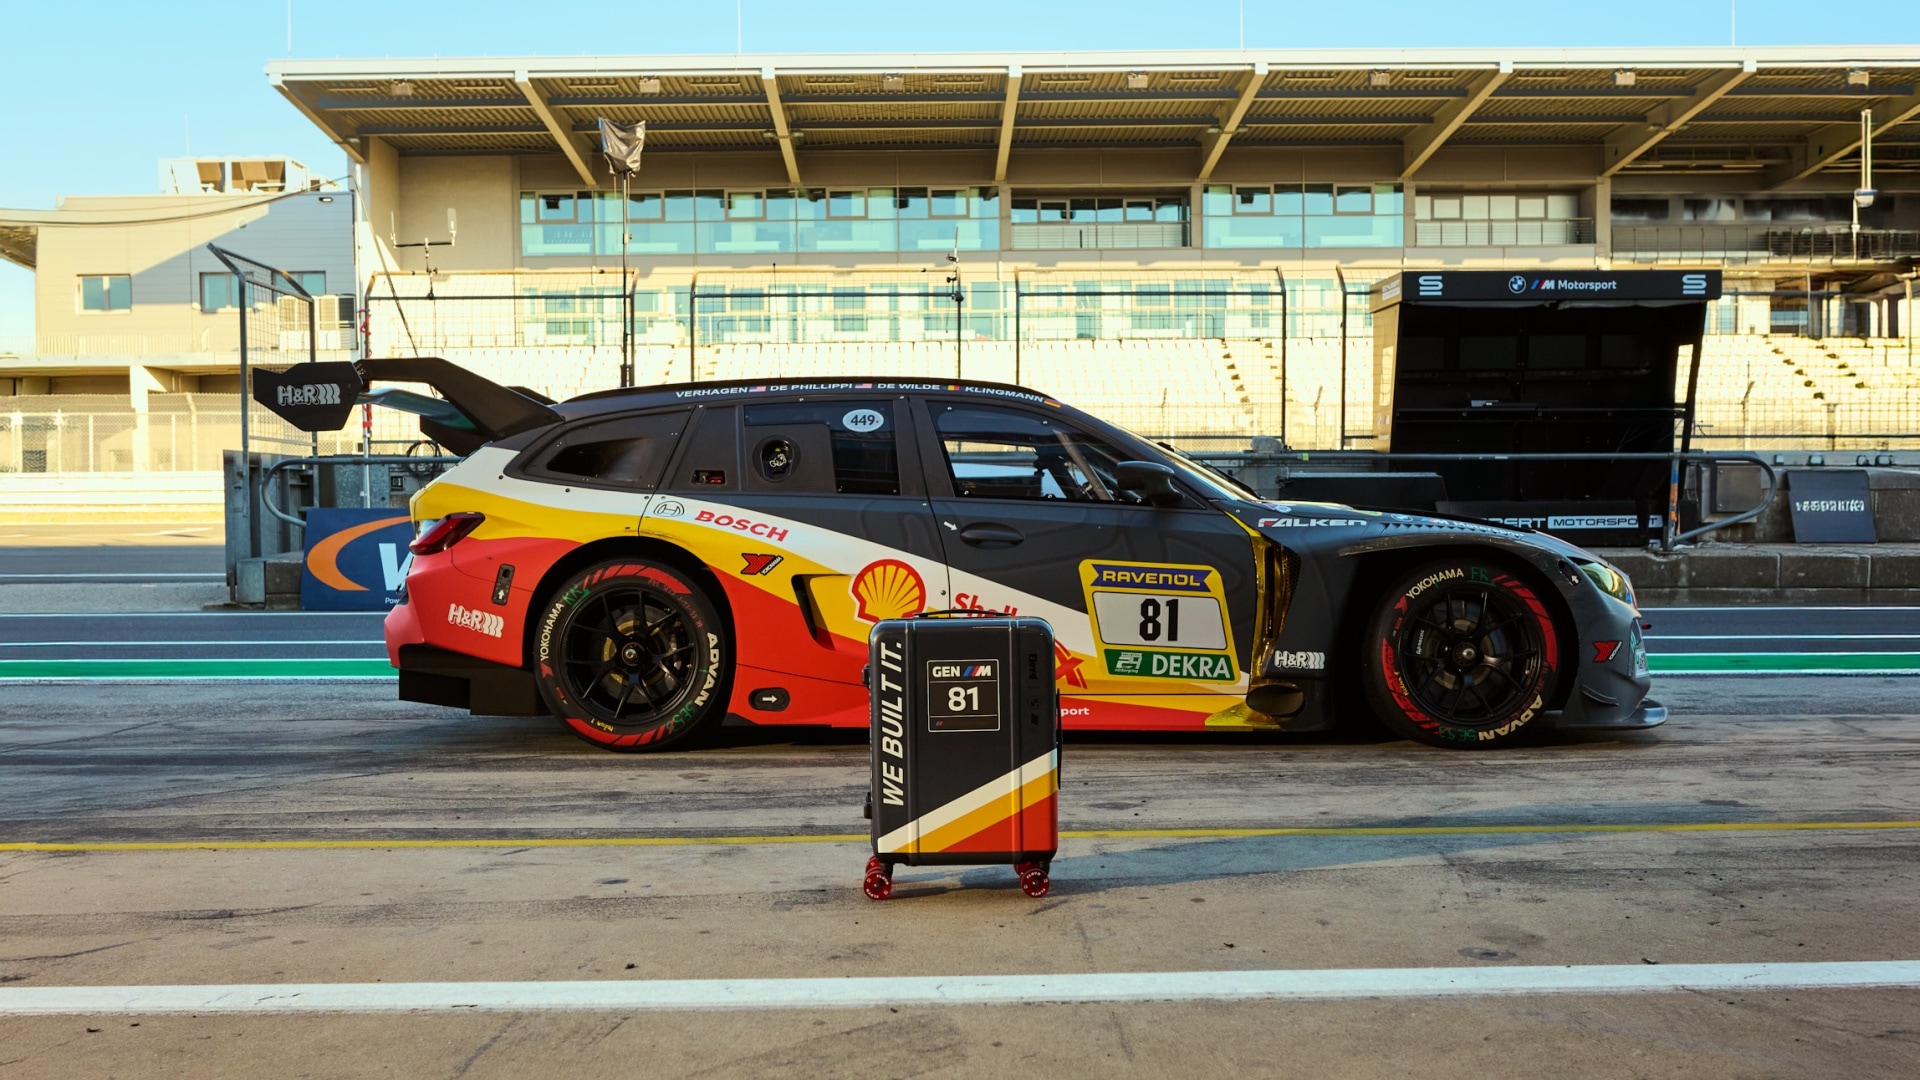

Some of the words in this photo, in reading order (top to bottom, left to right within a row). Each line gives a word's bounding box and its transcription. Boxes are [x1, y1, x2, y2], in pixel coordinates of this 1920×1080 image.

[1558, 280, 1617, 291] Motorsport
[277, 384, 319, 406] H&R
[676, 387, 748, 398] VERHAGEN
[791, 383, 853, 391] PHILLIPPI
[965, 386, 1044, 403] KLINGMANN
[851, 414, 876, 426] 449
[694, 510, 789, 542] BOSCH
[1258, 518, 1368, 528] FALKEN
[1553, 517, 1658, 527] MOTORSPOT
[1102, 570, 1201, 587] RAVENOL
[1405, 568, 1464, 600] YOKOHAMA
[448, 603, 484, 631] H&R
[1139, 598, 1179, 642] 81
[540, 602, 565, 662] YOKOHAMA
[881, 642, 903, 673] IT.
[1151, 655, 1231, 679] DEKRA
[1274, 650, 1308, 669] H&R
[694, 632, 720, 707] ADVAN
[932, 666, 961, 677] GEN
[948, 686, 979, 712] 81
[881, 674, 904, 759] BUILT
[1056, 707, 1090, 717] port
[1478, 694, 1544, 741] ADVAN
[883, 761, 905, 806] WE
